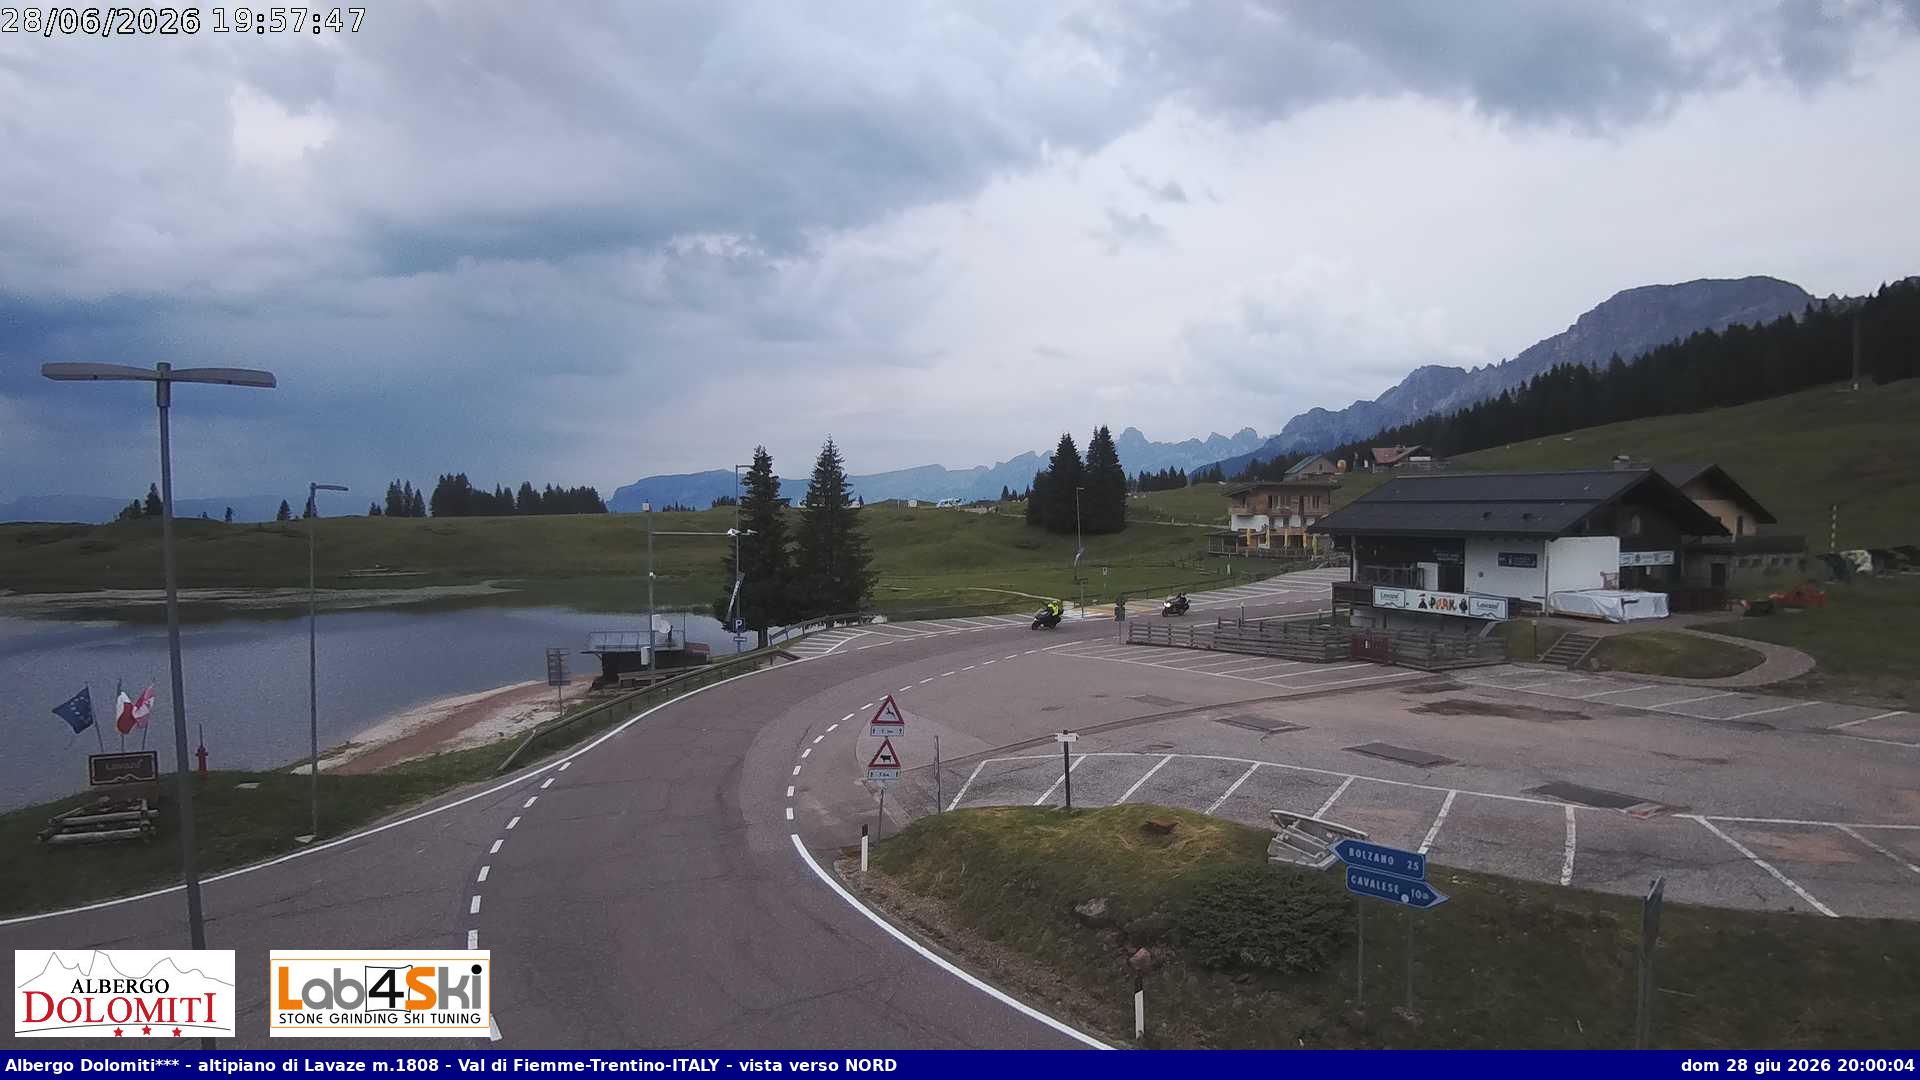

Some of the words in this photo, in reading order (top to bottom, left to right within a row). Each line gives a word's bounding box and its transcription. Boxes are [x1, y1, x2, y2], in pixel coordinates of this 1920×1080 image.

[735, 619, 742, 629] P
[1348, 847, 1394, 865] BOLZANO
[1407, 860, 1419, 871] 25
[1350, 874, 1400, 895] CAVALESE
